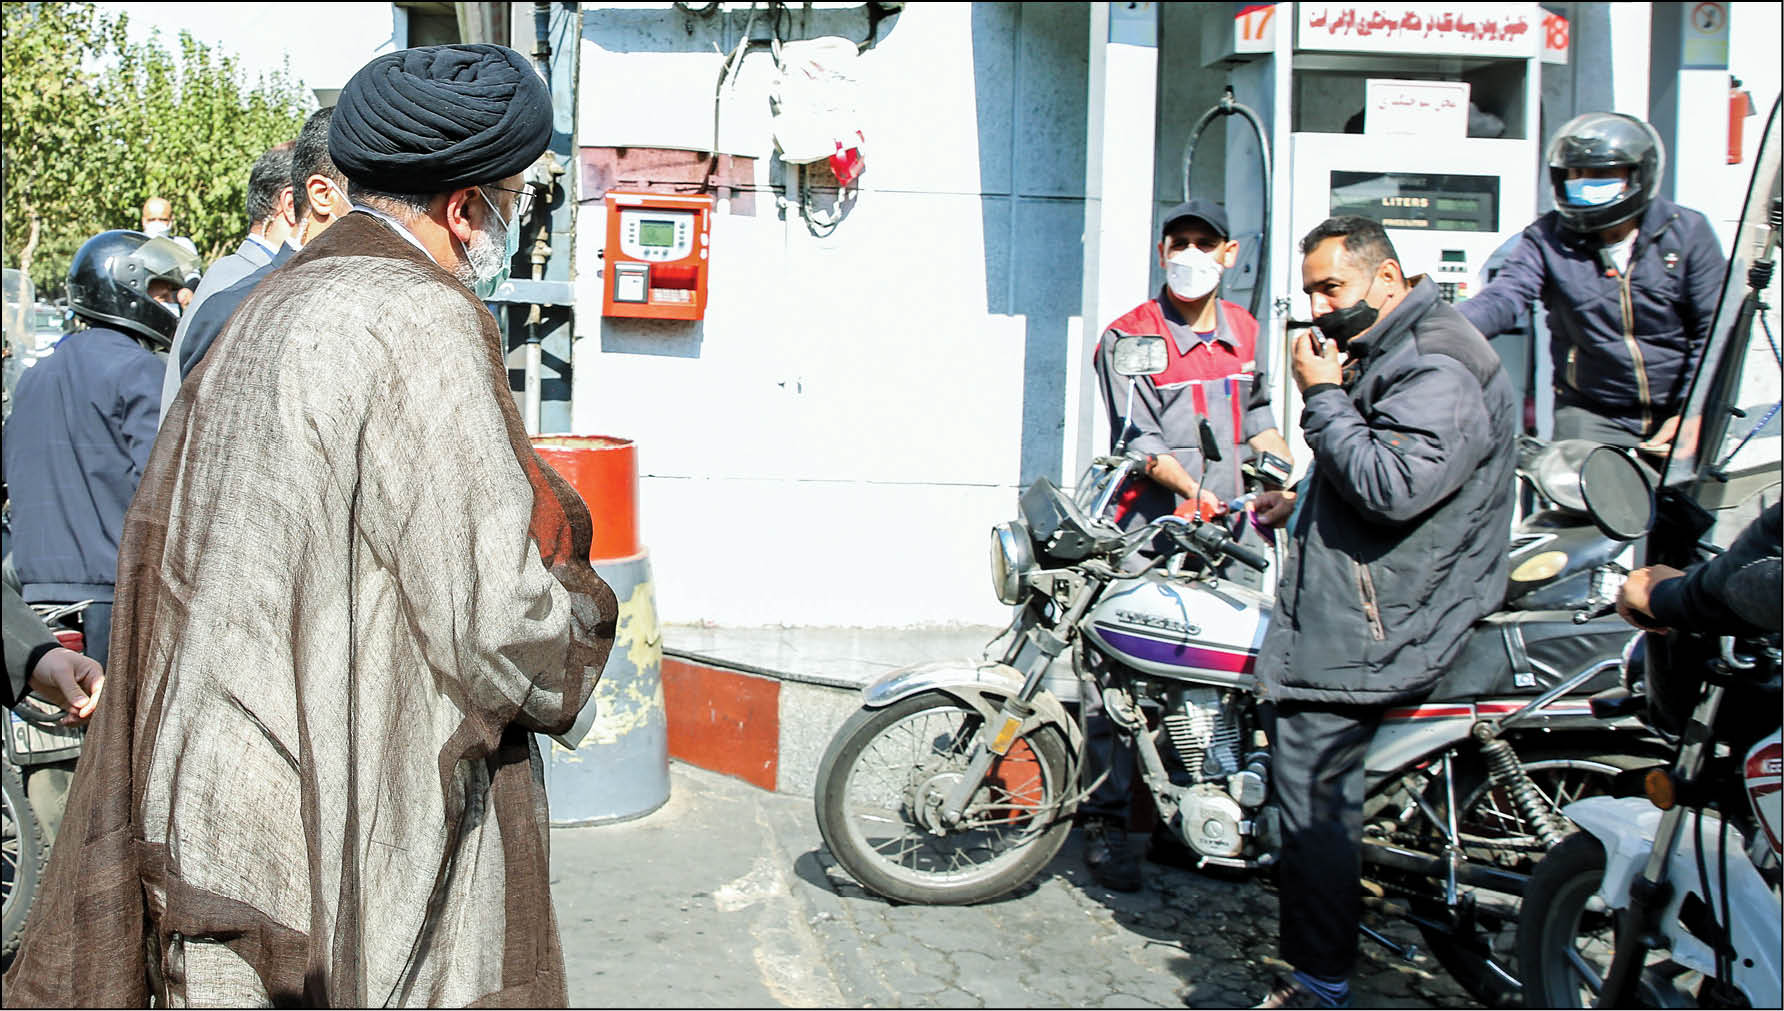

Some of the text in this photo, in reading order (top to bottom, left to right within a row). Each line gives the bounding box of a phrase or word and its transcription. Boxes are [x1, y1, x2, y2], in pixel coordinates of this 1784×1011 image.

[1242, 6, 1276, 41] 17
[1541, 15, 1570, 50] 18
[1382, 197, 1429, 207] LITERS
